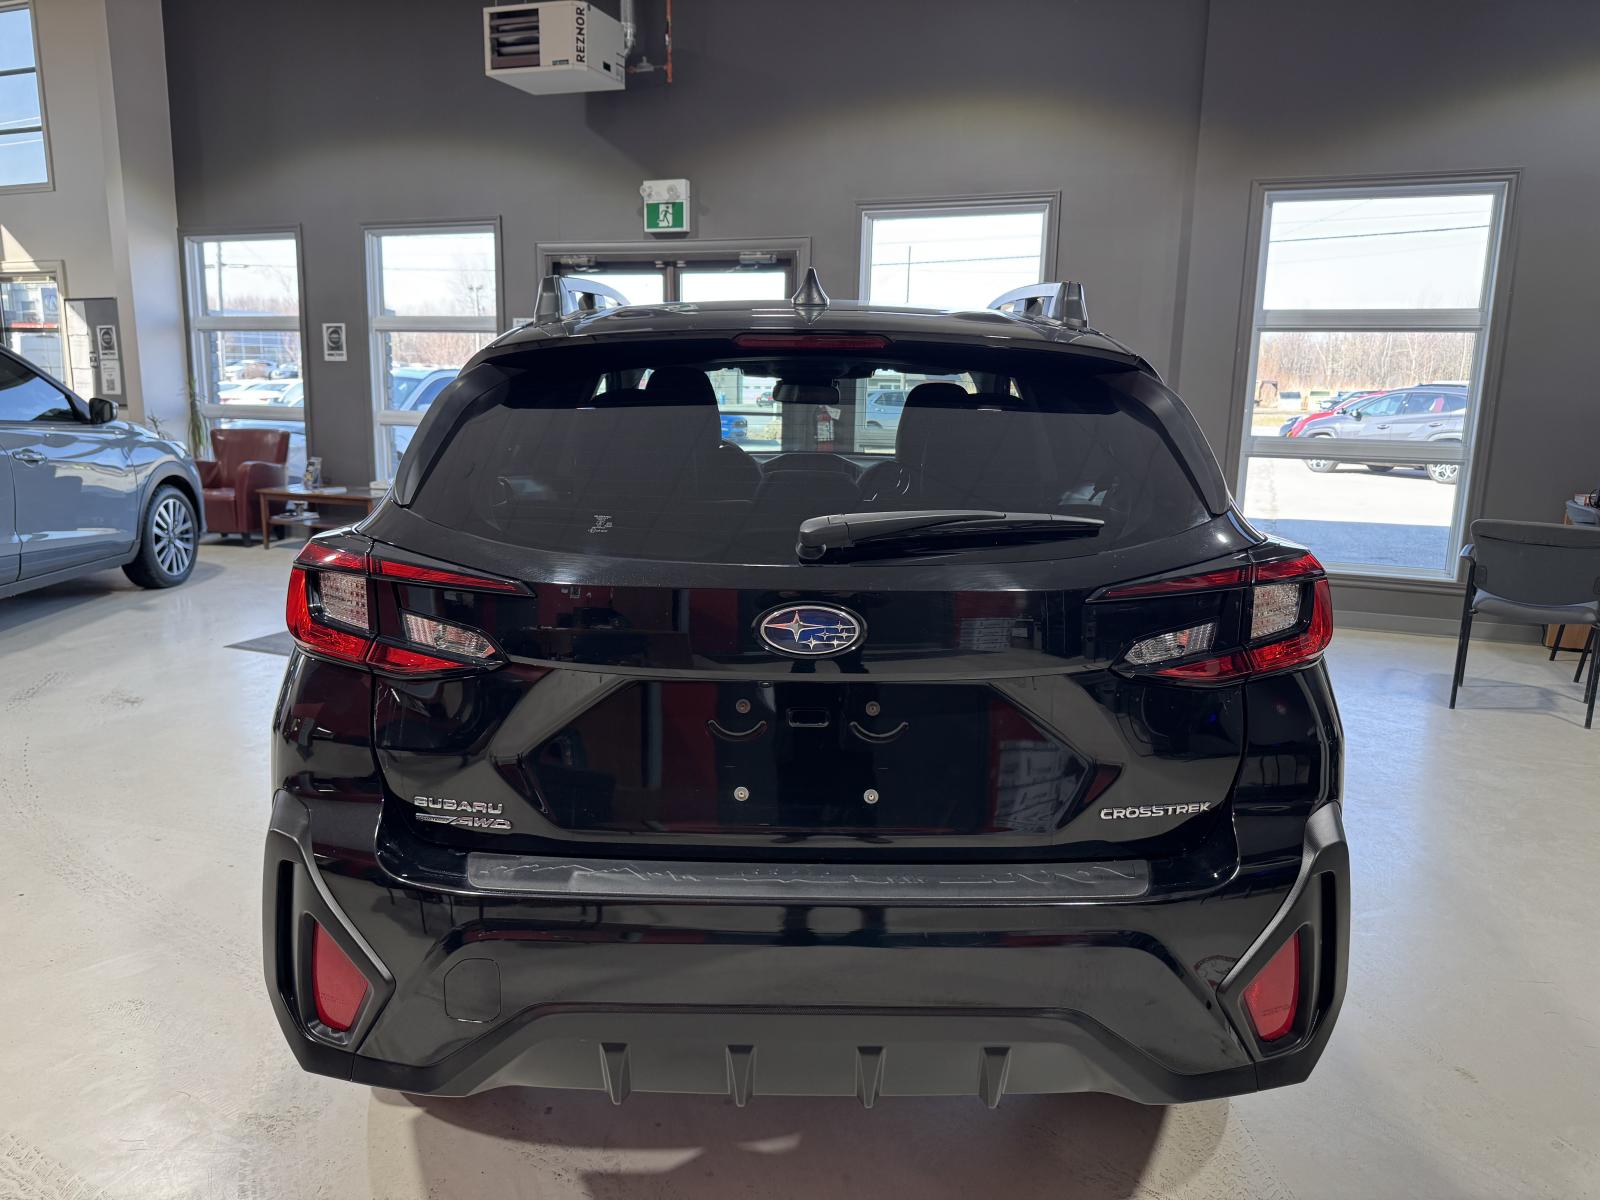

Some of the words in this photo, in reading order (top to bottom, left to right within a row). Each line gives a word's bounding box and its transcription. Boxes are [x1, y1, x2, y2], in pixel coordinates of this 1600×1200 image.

[576, 7, 585, 63] REZNOR
[414, 796, 502, 814] SUBARU
[1101, 802, 1212, 820] CROSSTREK
[450, 816, 511, 829] AWD
